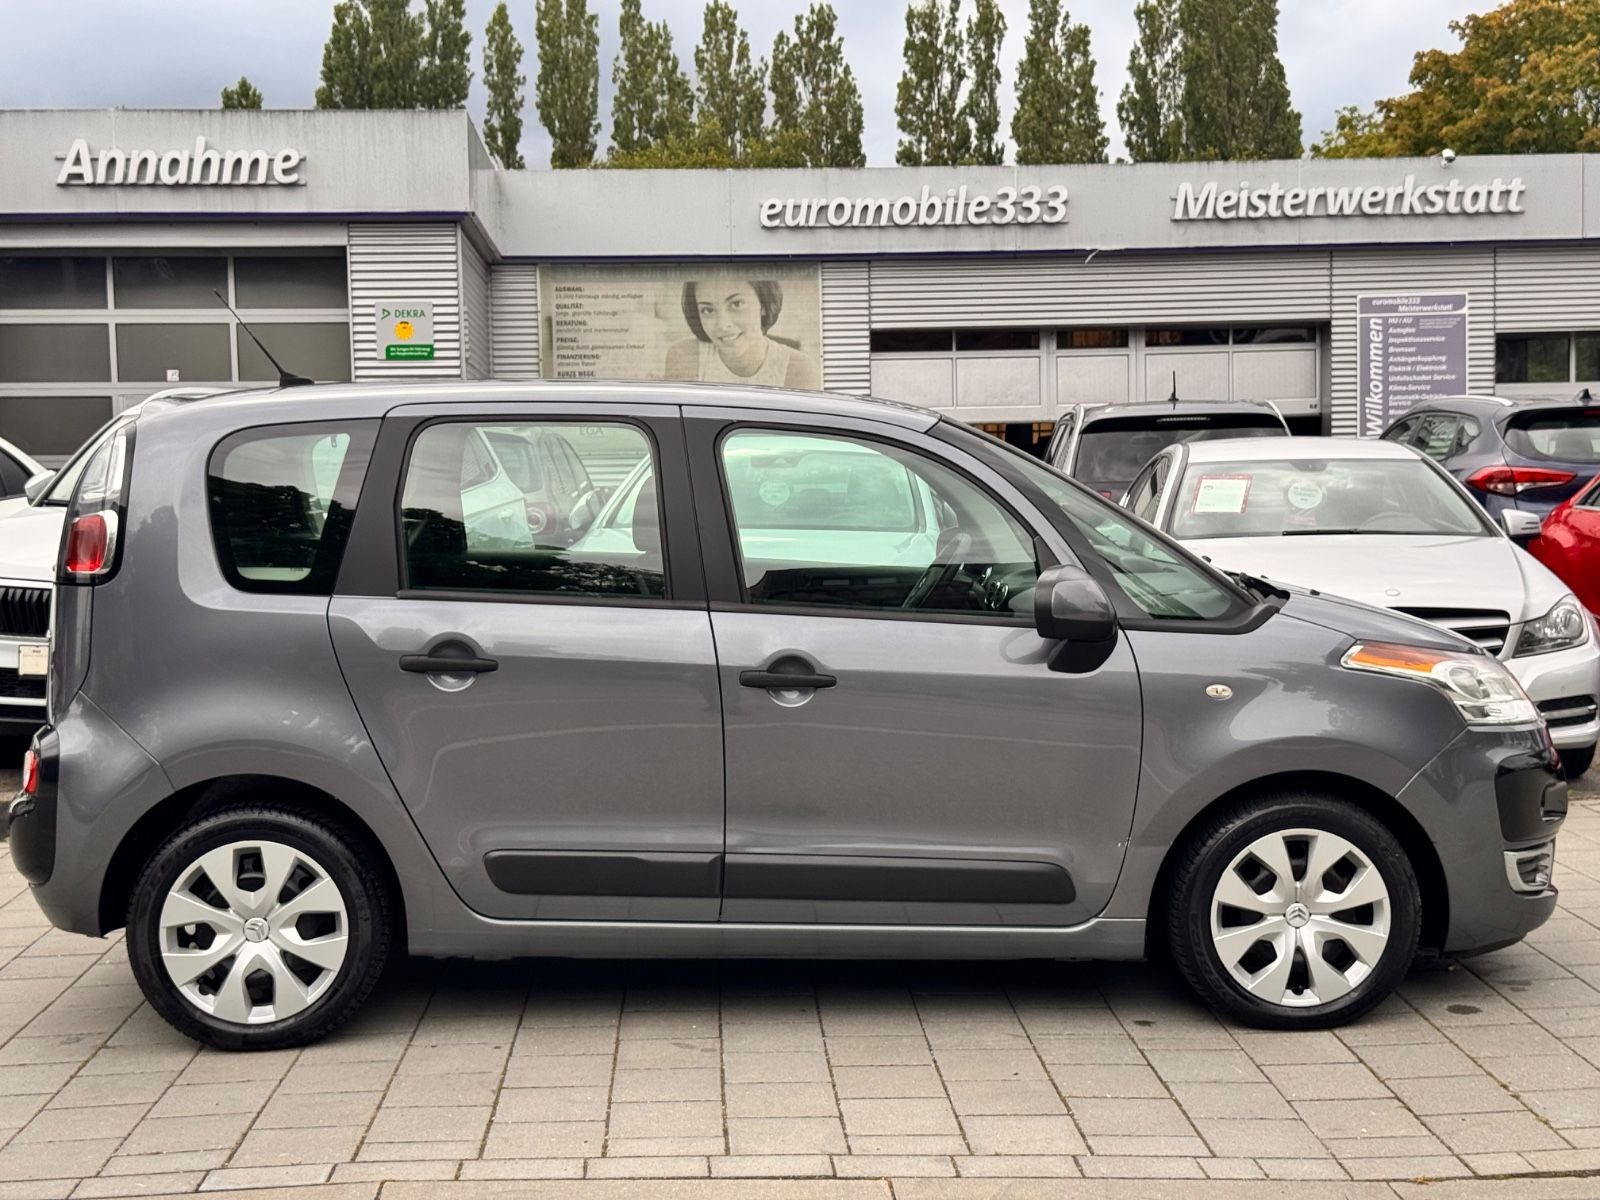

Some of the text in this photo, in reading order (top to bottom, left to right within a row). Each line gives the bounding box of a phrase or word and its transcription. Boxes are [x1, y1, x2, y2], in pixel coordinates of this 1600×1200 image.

[56, 135, 300, 185] Annahme
[760, 185, 1068, 228] euromobile333
[1173, 174, 1526, 220] Meisterwerkstatt
[394, 309, 427, 318] DEKRA
[1372, 297, 1421, 306] euromobile333
[1397, 303, 1454, 313] Meisterwerkstatt
